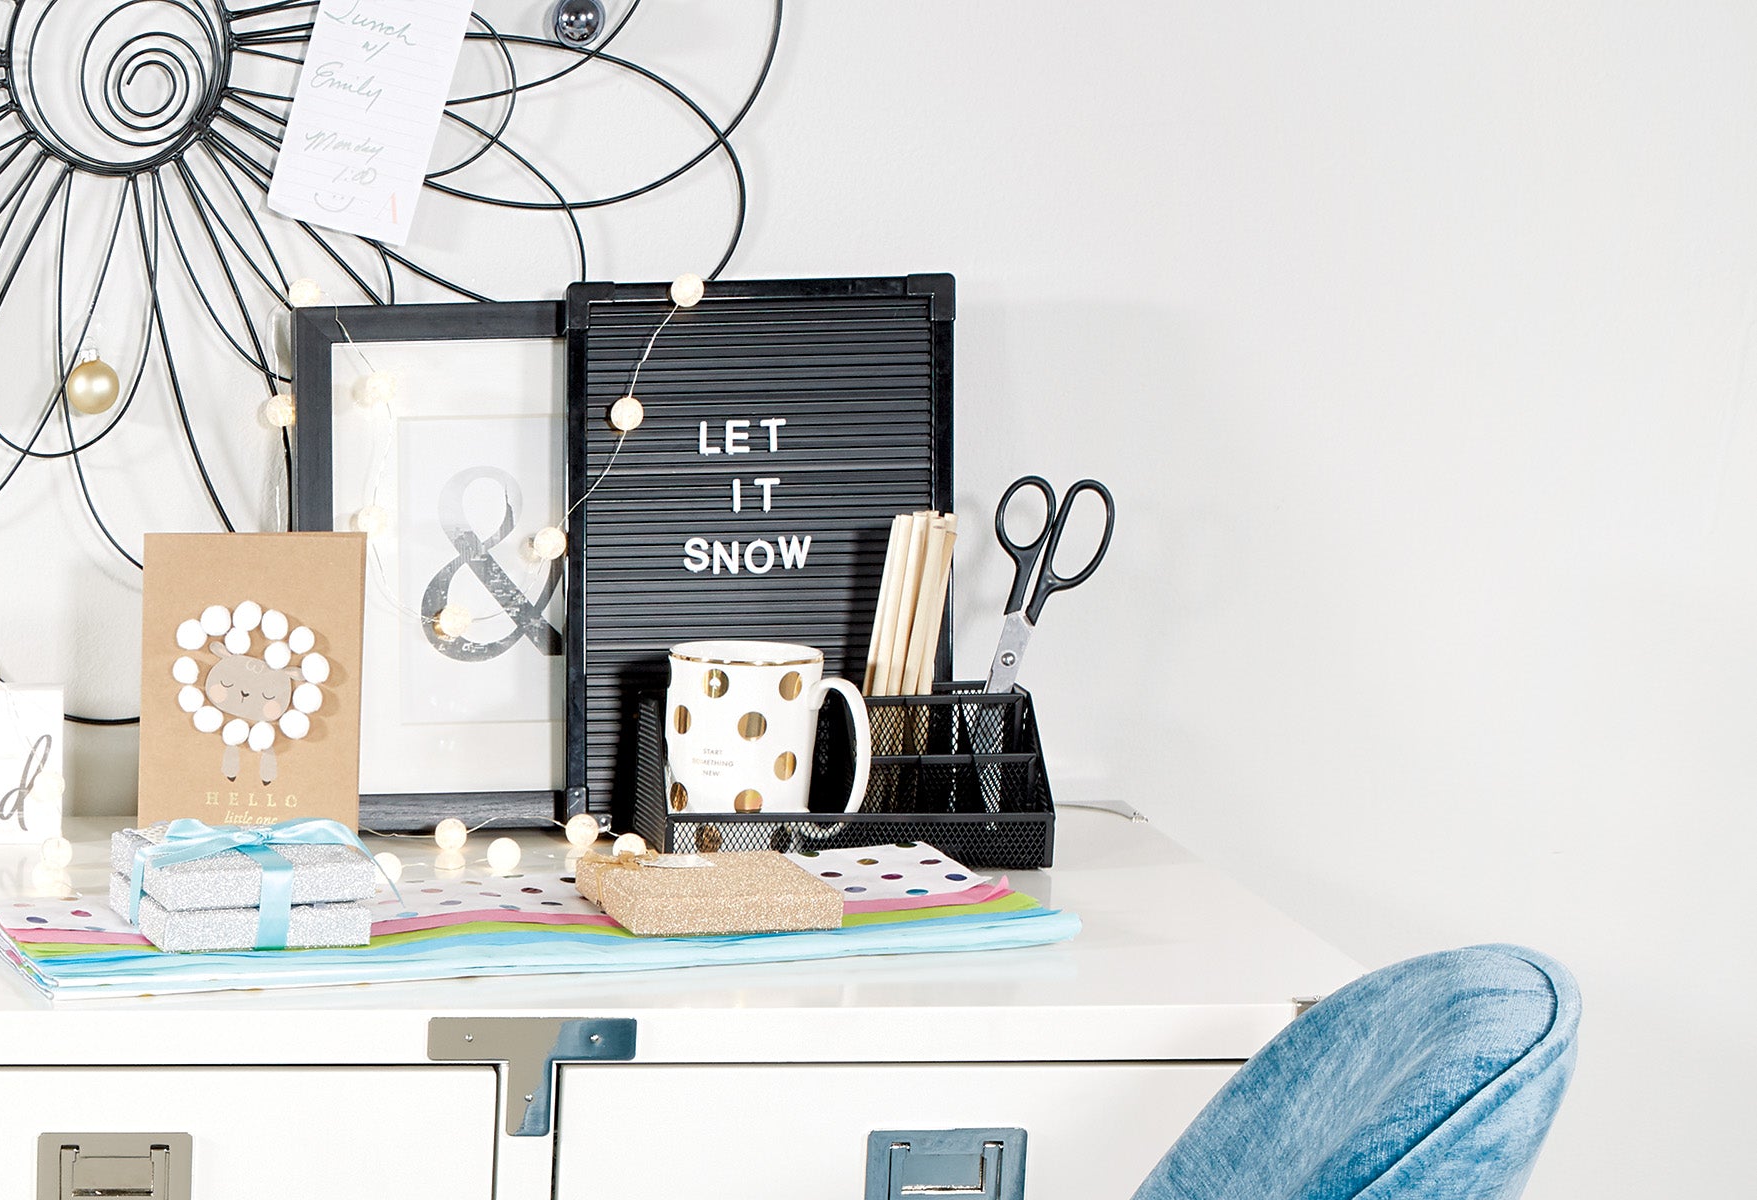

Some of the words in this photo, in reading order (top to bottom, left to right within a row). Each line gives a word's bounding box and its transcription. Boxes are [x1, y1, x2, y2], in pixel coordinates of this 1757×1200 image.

[310, 61, 383, 113] Emily
[305, 129, 385, 164] Monday
[699, 418, 787, 455] LET
[732, 477, 781, 513] IT
[683, 535, 812, 575] SNOW
[205, 791, 298, 808] HELLO
[224, 810, 253, 825] little
[255, 816, 278, 825] one
